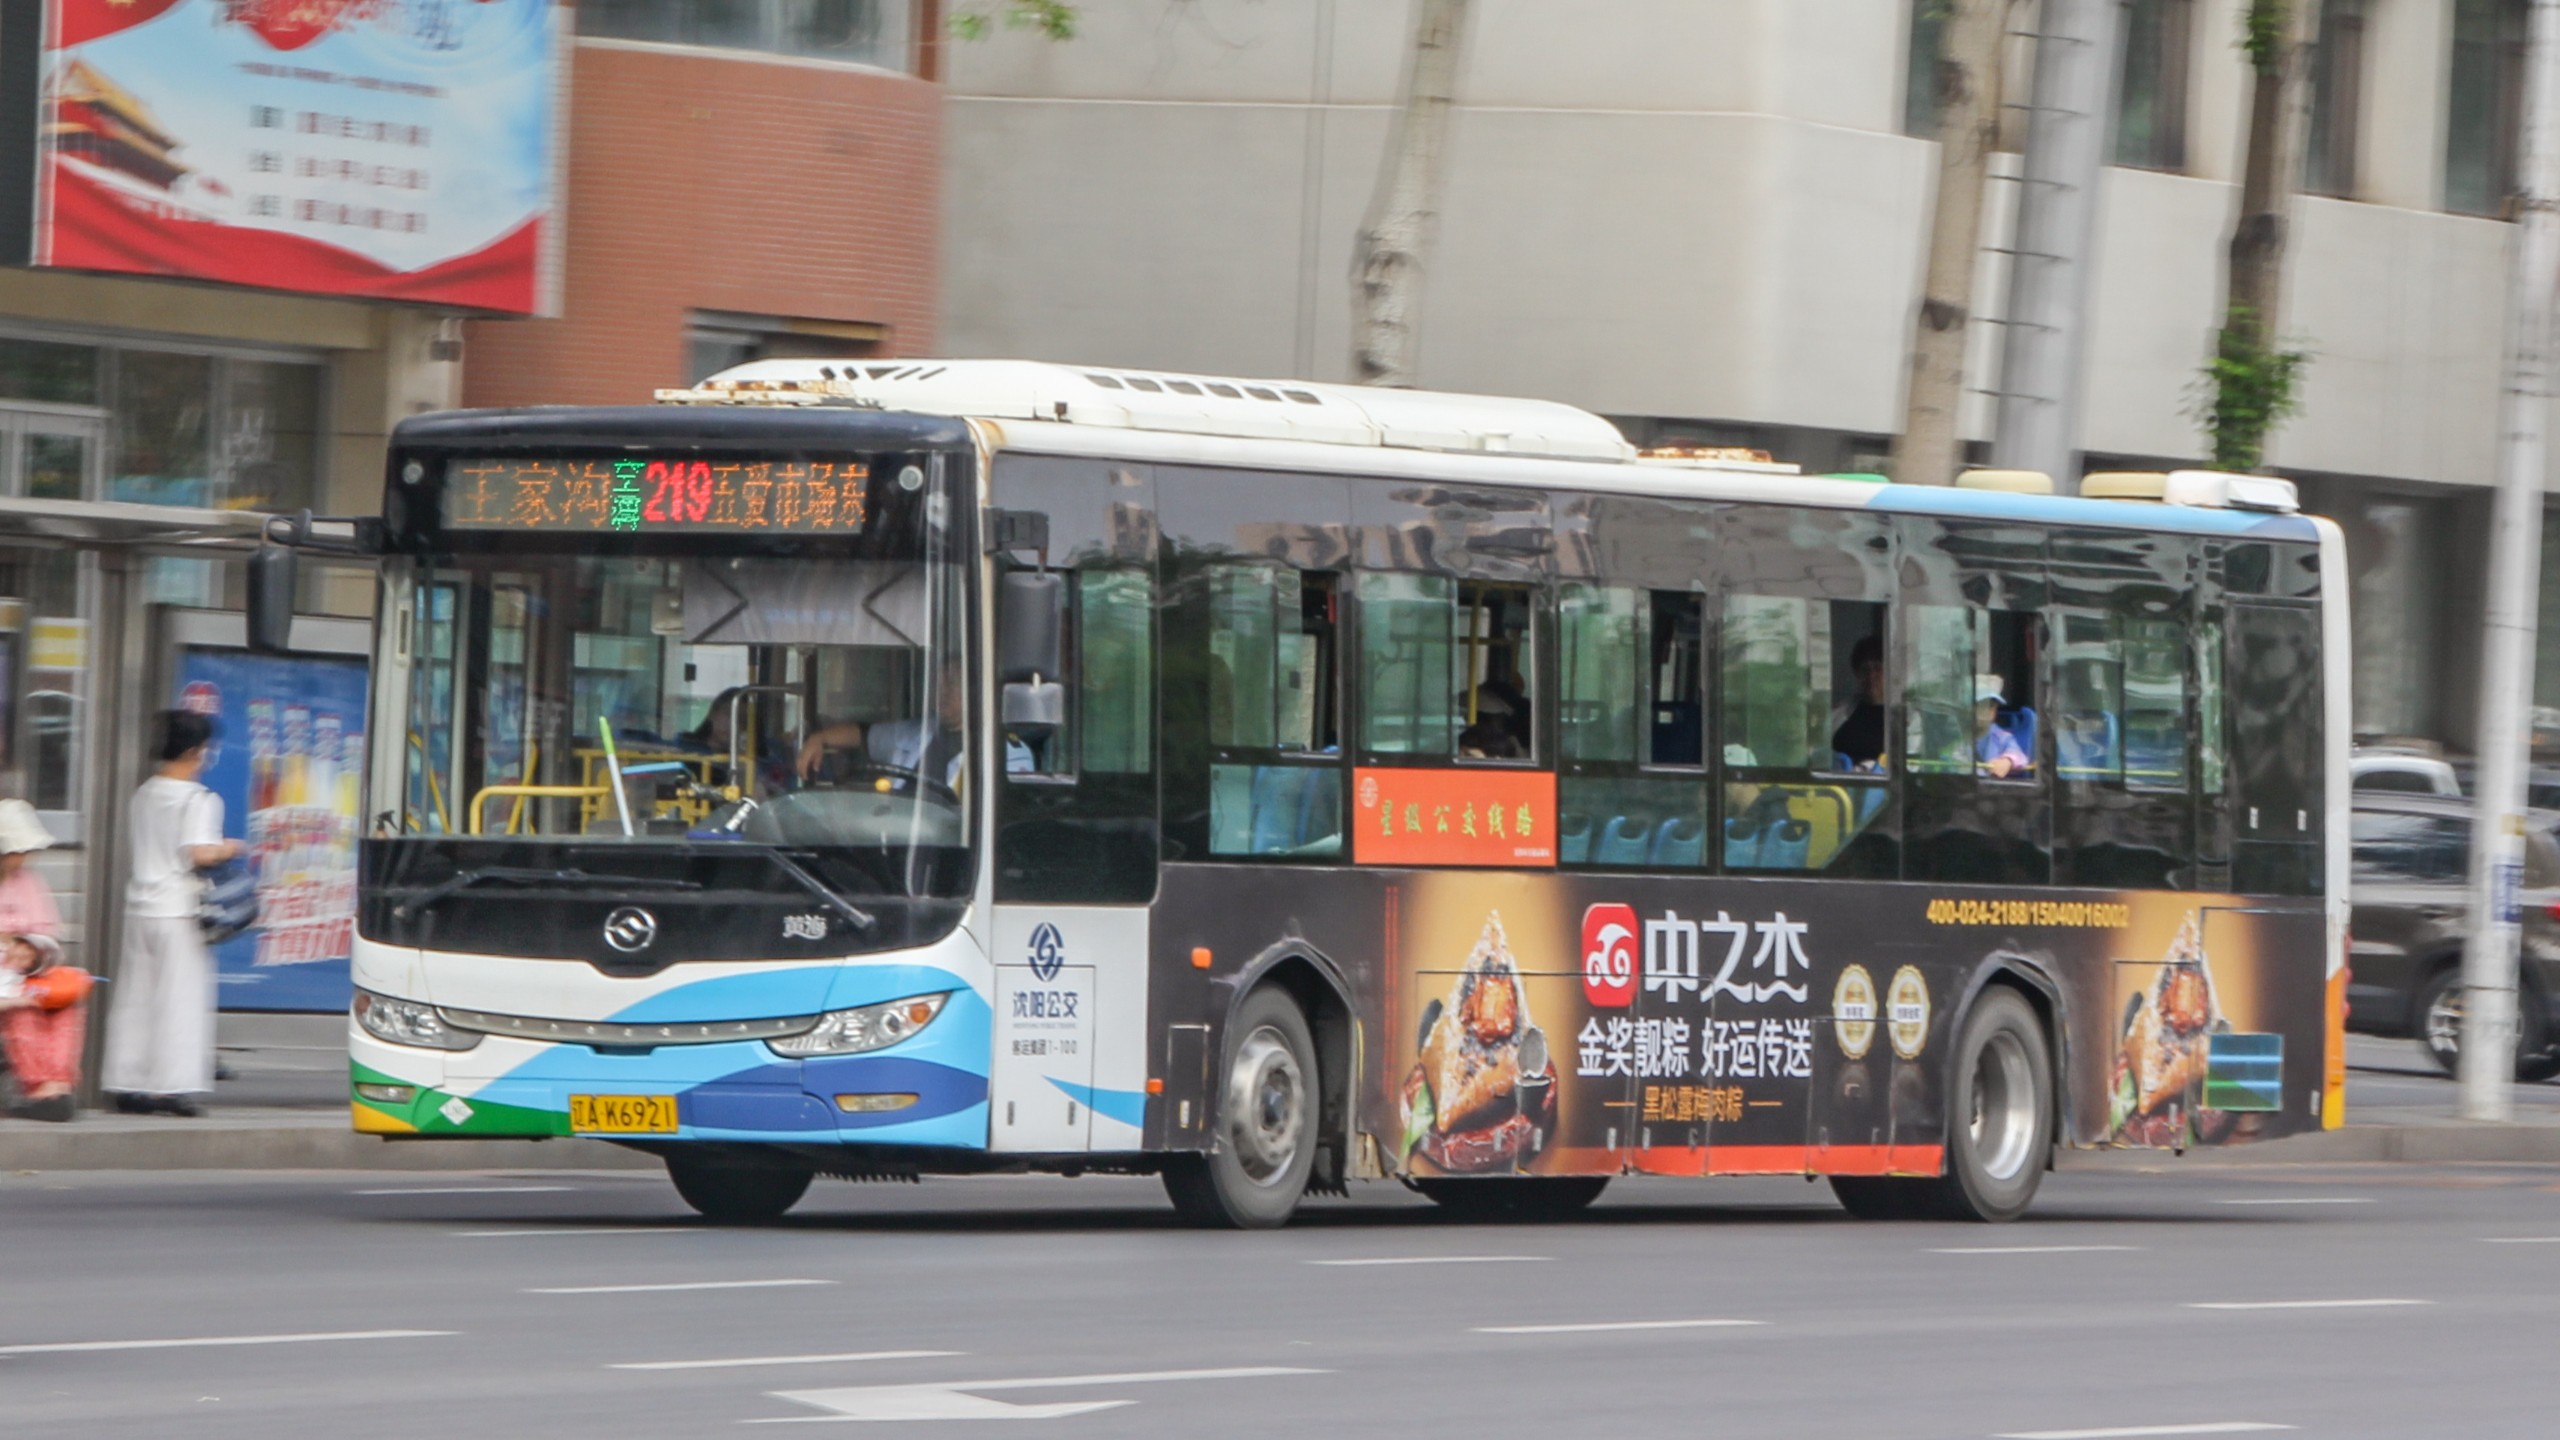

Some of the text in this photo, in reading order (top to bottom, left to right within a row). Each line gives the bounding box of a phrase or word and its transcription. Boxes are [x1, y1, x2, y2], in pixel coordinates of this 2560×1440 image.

[643, 460, 714, 523] 219
[782, 914, 828, 940] 黄海
[1012, 991, 1079, 1018] 沈阳公交
[1576, 1016, 1813, 1079] 金奖靓粽 好运传送
